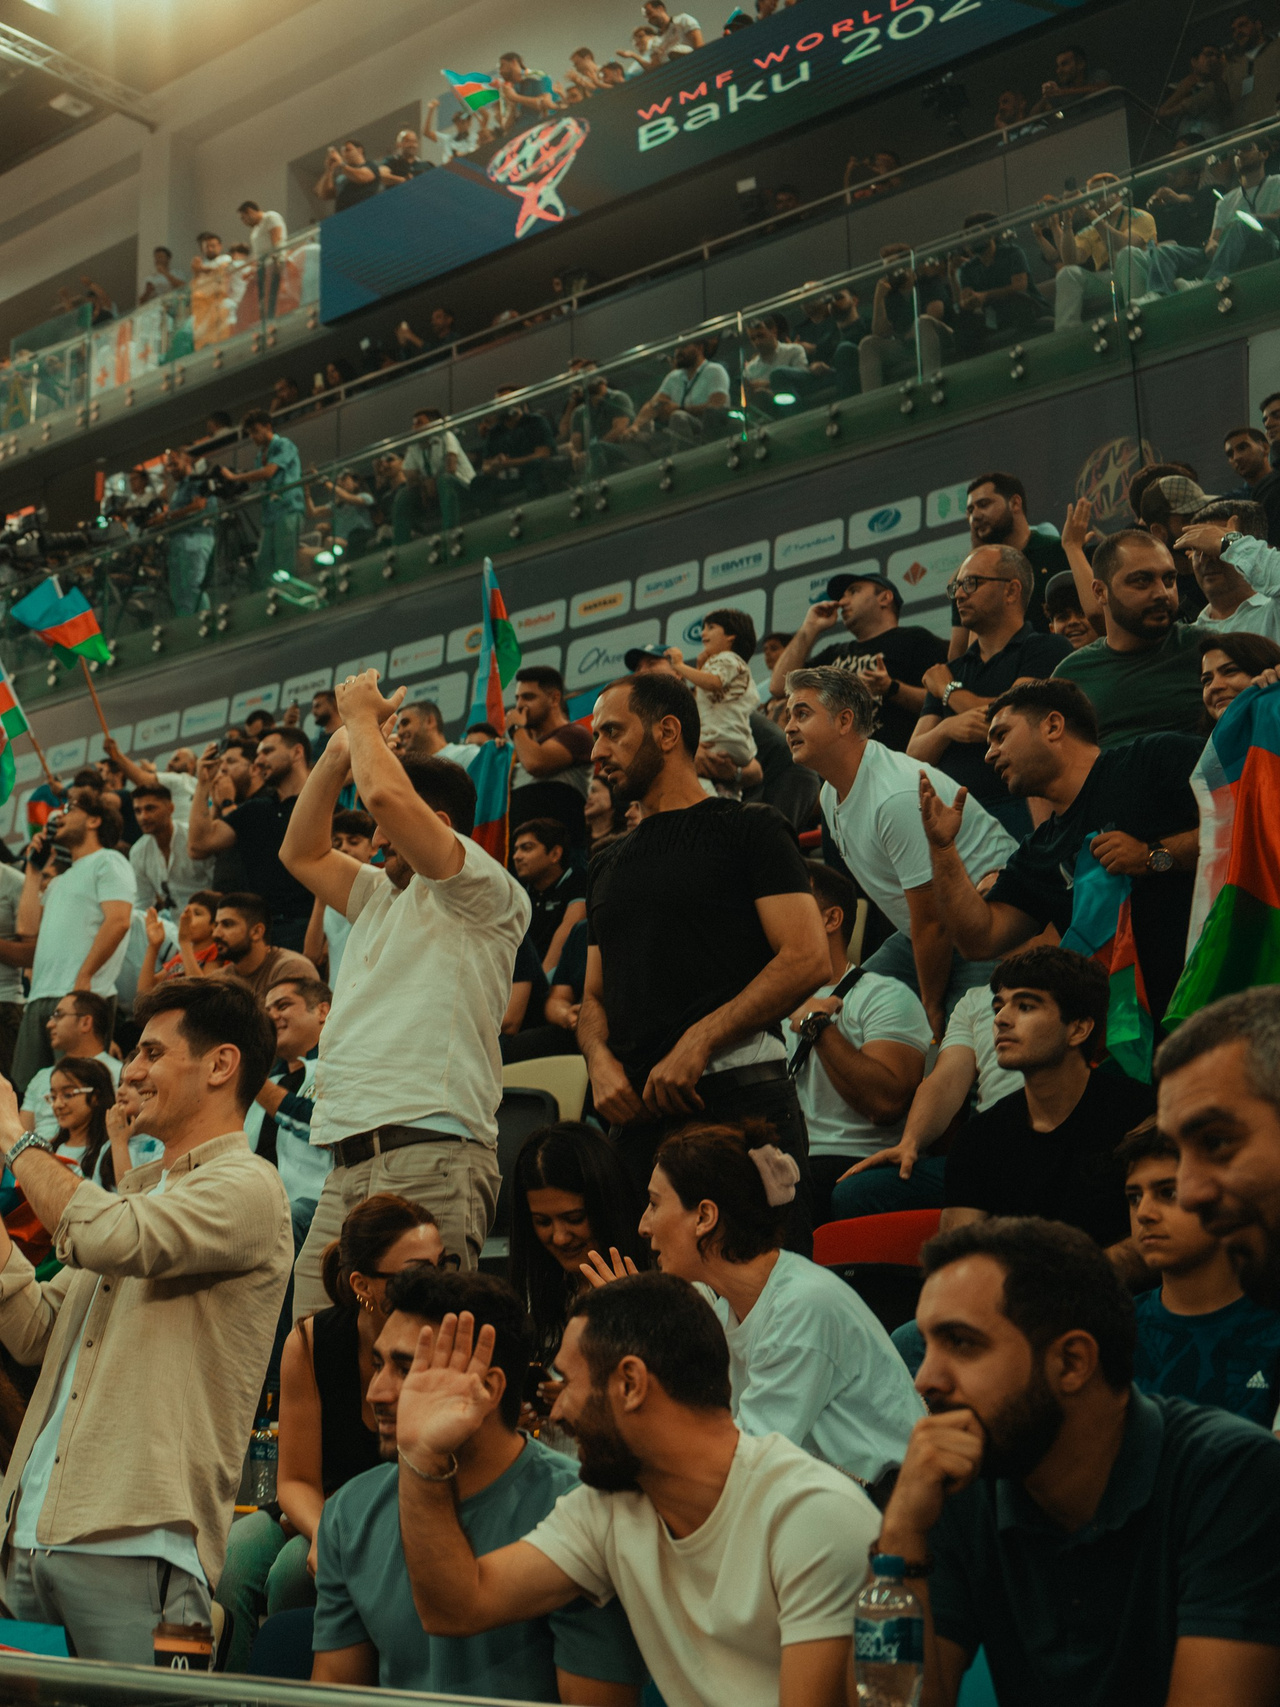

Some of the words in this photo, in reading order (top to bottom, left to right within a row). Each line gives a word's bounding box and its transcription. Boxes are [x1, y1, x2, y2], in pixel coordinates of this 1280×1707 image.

[637, 69, 733, 120] WMF
[753, 0, 916, 69] WORLD
[637, 61, 811, 152] Baku
